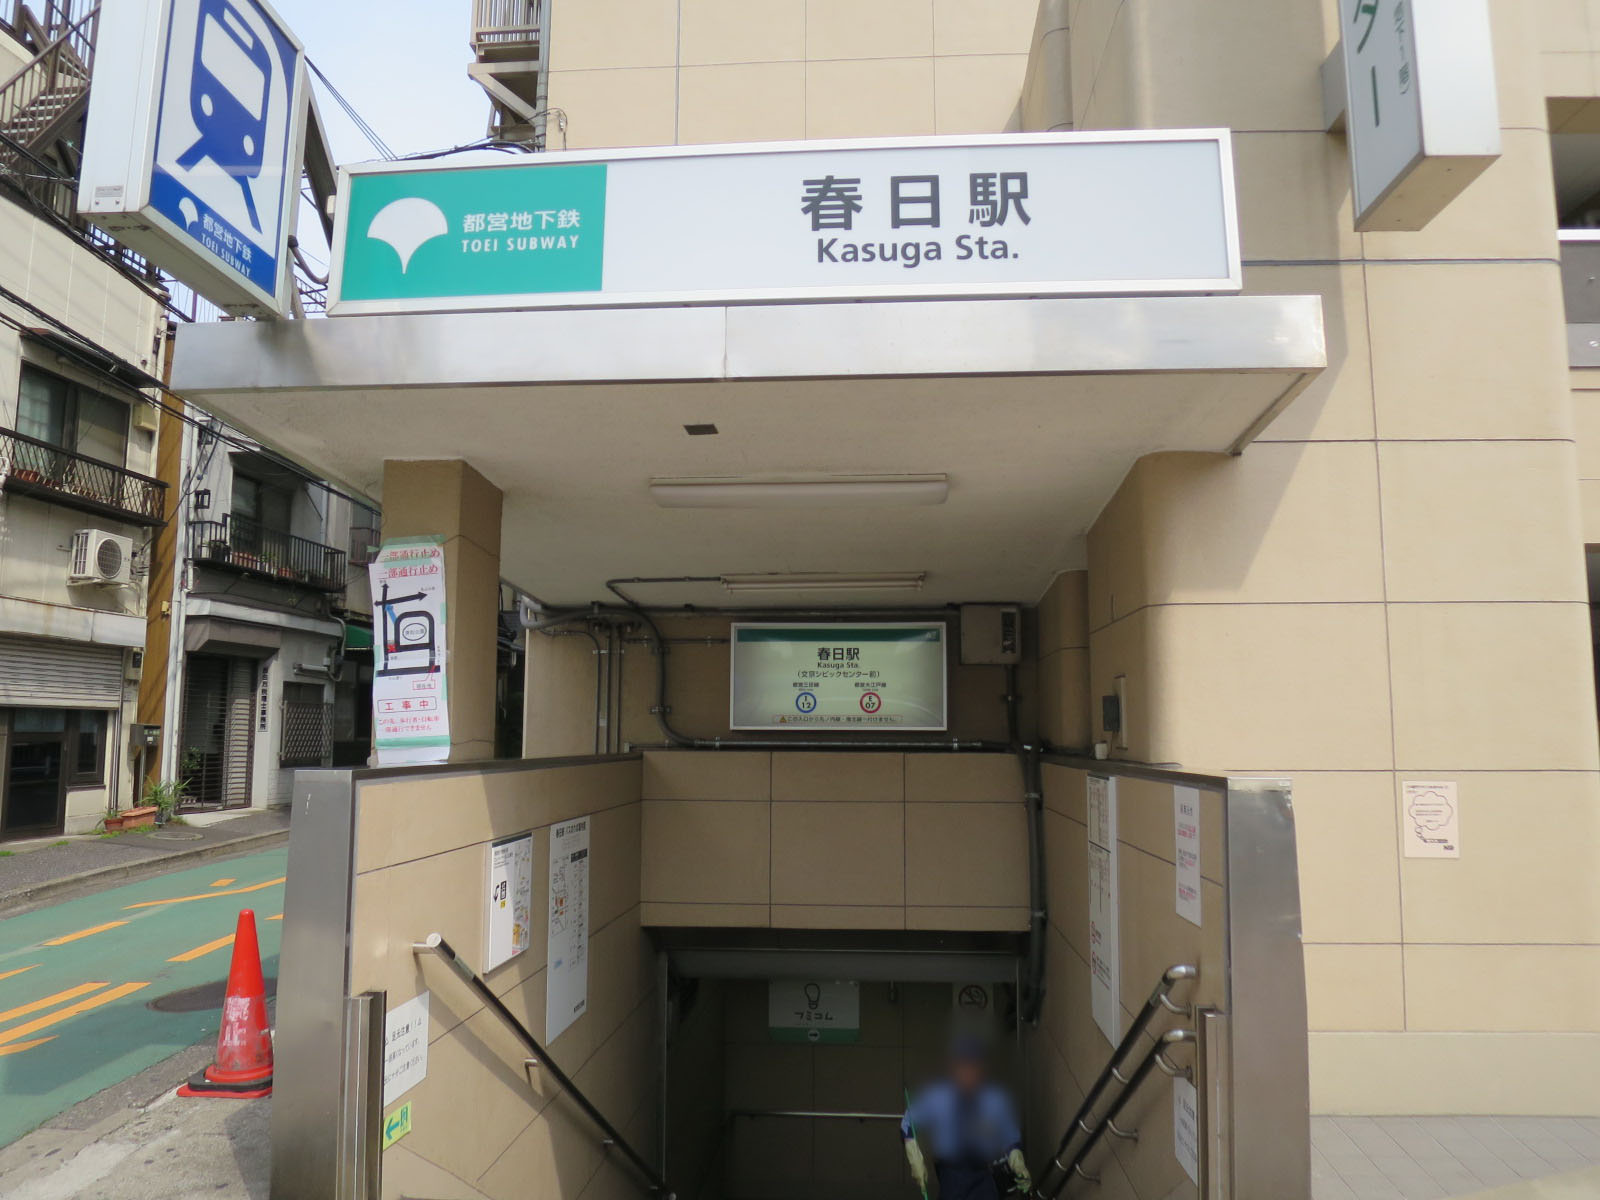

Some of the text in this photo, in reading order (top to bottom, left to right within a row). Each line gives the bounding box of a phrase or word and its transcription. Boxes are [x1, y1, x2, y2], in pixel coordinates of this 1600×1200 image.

[801, 171, 1031, 231] 春日駅
[463, 209, 580, 233] 都営地下鉄
[203, 213, 252, 263] 都営地下鉄
[462, 234, 579, 253] TOEI SUBWAY
[201, 233, 251, 277] TOEI SUBWAY
[817, 234, 1019, 268] Kasuga Sta.
[817, 647, 860, 661] 春日駅
[817, 662, 845, 670] Kasuga
[384, 699, 429, 711] 工事中
[794, 1010, 833, 1022] フミコム
